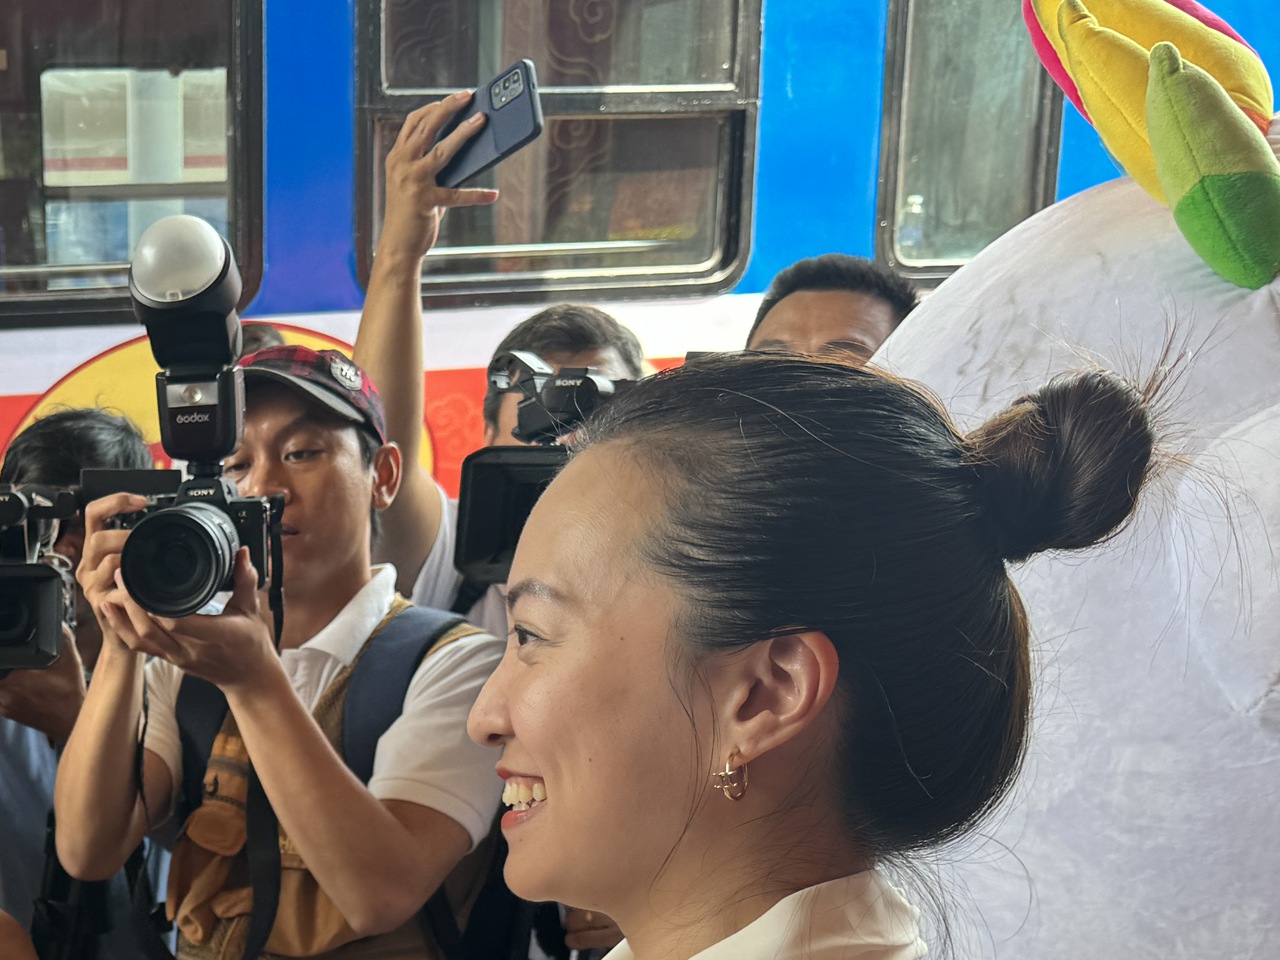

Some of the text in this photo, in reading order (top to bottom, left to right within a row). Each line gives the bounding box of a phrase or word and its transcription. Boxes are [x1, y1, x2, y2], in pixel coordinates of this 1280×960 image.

[555, 379, 583, 387] SONY
[176, 412, 210, 424] Godox
[187, 489, 216, 497] SONY
